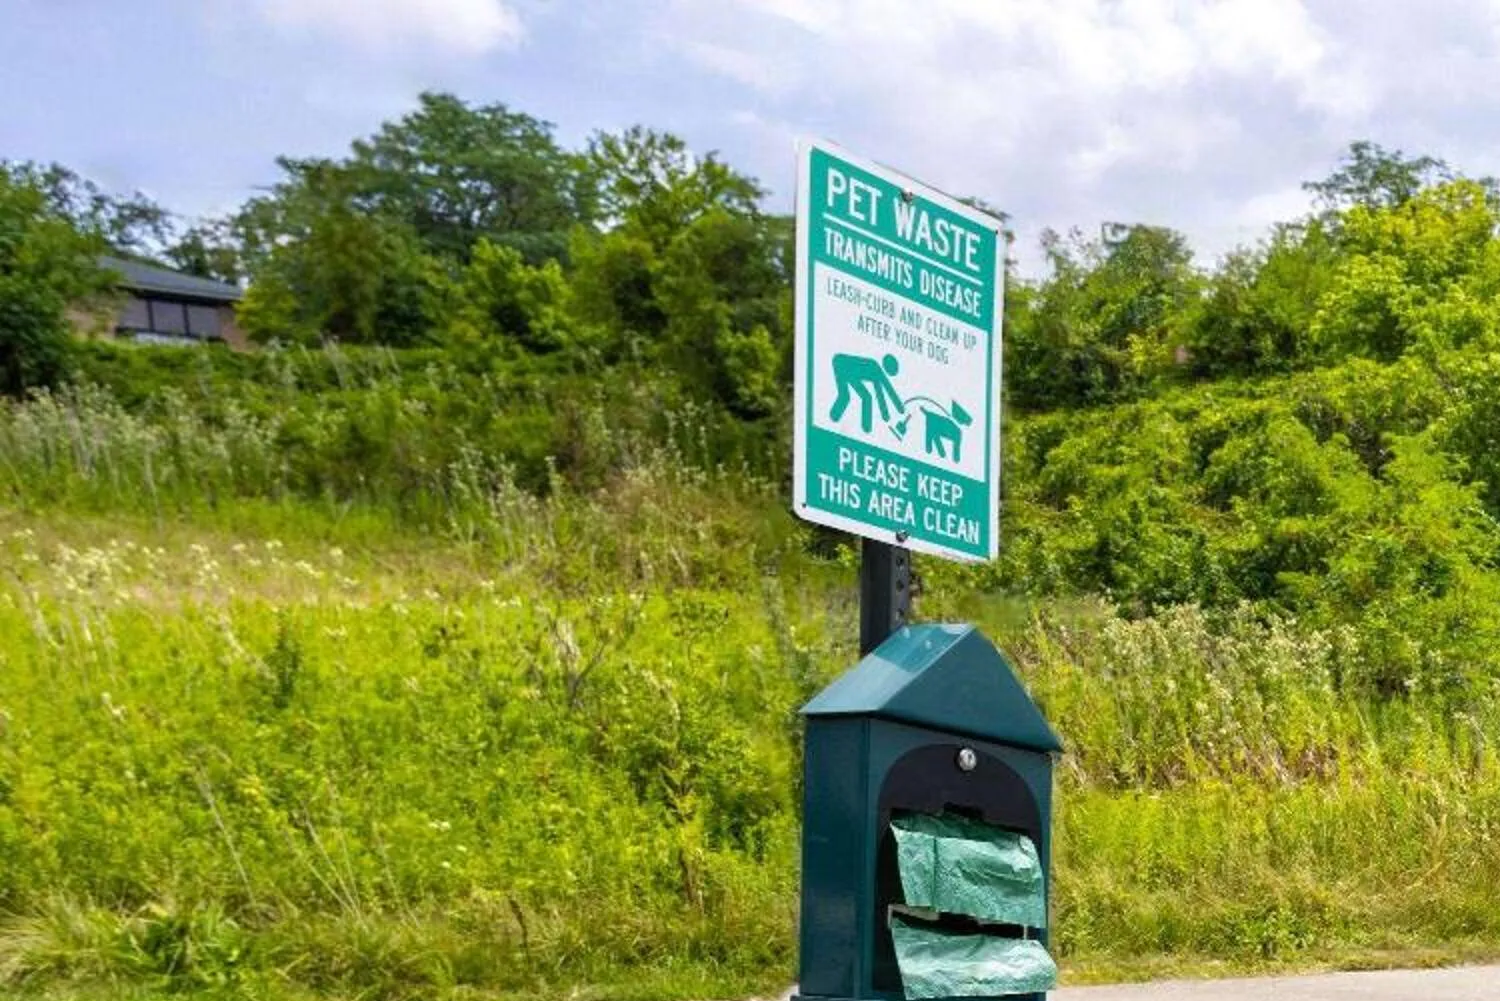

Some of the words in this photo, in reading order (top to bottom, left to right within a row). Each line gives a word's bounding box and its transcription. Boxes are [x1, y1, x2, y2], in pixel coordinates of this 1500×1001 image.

[826, 167, 881, 224] PET
[894, 196, 980, 271] WASTE
[824, 227, 914, 289] TRANSMITS
[919, 268, 981, 318] DISEASE
[827, 277, 896, 319] LEASH-CURB
[899, 307, 923, 331] AND
[926, 316, 958, 343] CLEAN
[963, 329, 977, 351] UP
[857, 314, 891, 342] AFTER
[894, 329, 924, 355] YOUR
[928, 343, 949, 365] DOG
[818, 472, 861, 508] THIS
[867, 493, 915, 527] AREA
[923, 508, 979, 545] CLEAN
[838, 447, 909, 492] PLEASE
[917, 473, 963, 507] KEEP
